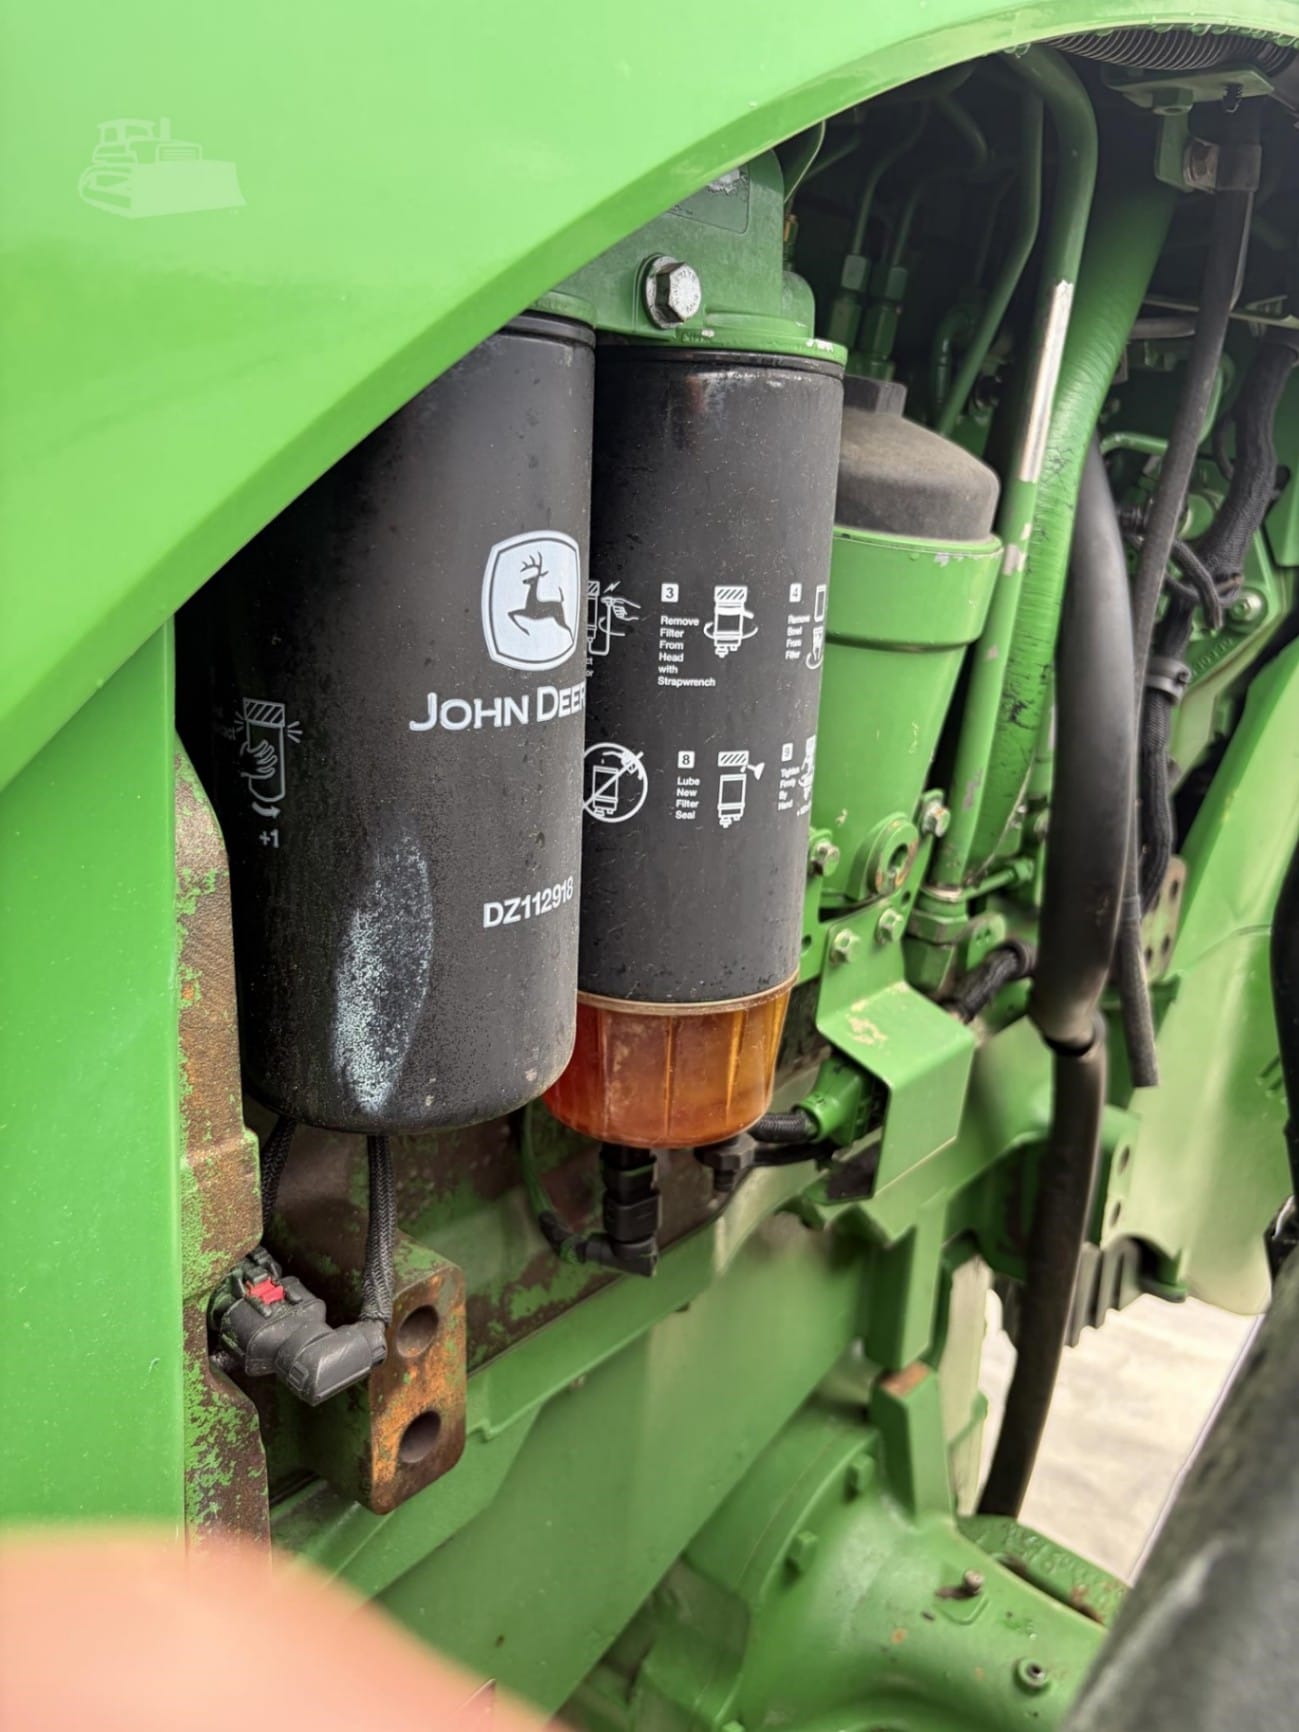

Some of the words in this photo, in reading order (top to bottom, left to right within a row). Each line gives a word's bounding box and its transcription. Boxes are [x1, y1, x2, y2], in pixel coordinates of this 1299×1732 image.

[661, 615, 700, 626] Remove
[660, 628, 684, 638] Filter
[659, 640, 684, 650] From
[659, 652, 684, 662] Head
[658, 665, 679, 675] with
[657, 677, 716, 688] Strapwrench
[409, 692, 530, 731] JOHN
[536, 681, 587, 722] DEER
[677, 776, 701, 786] Lube
[676, 787, 698, 797] New
[676, 799, 700, 809] Filter
[674, 809, 696, 820] Seal
[259, 828, 280, 848] +1
[483, 876, 574, 928] DZ112918
